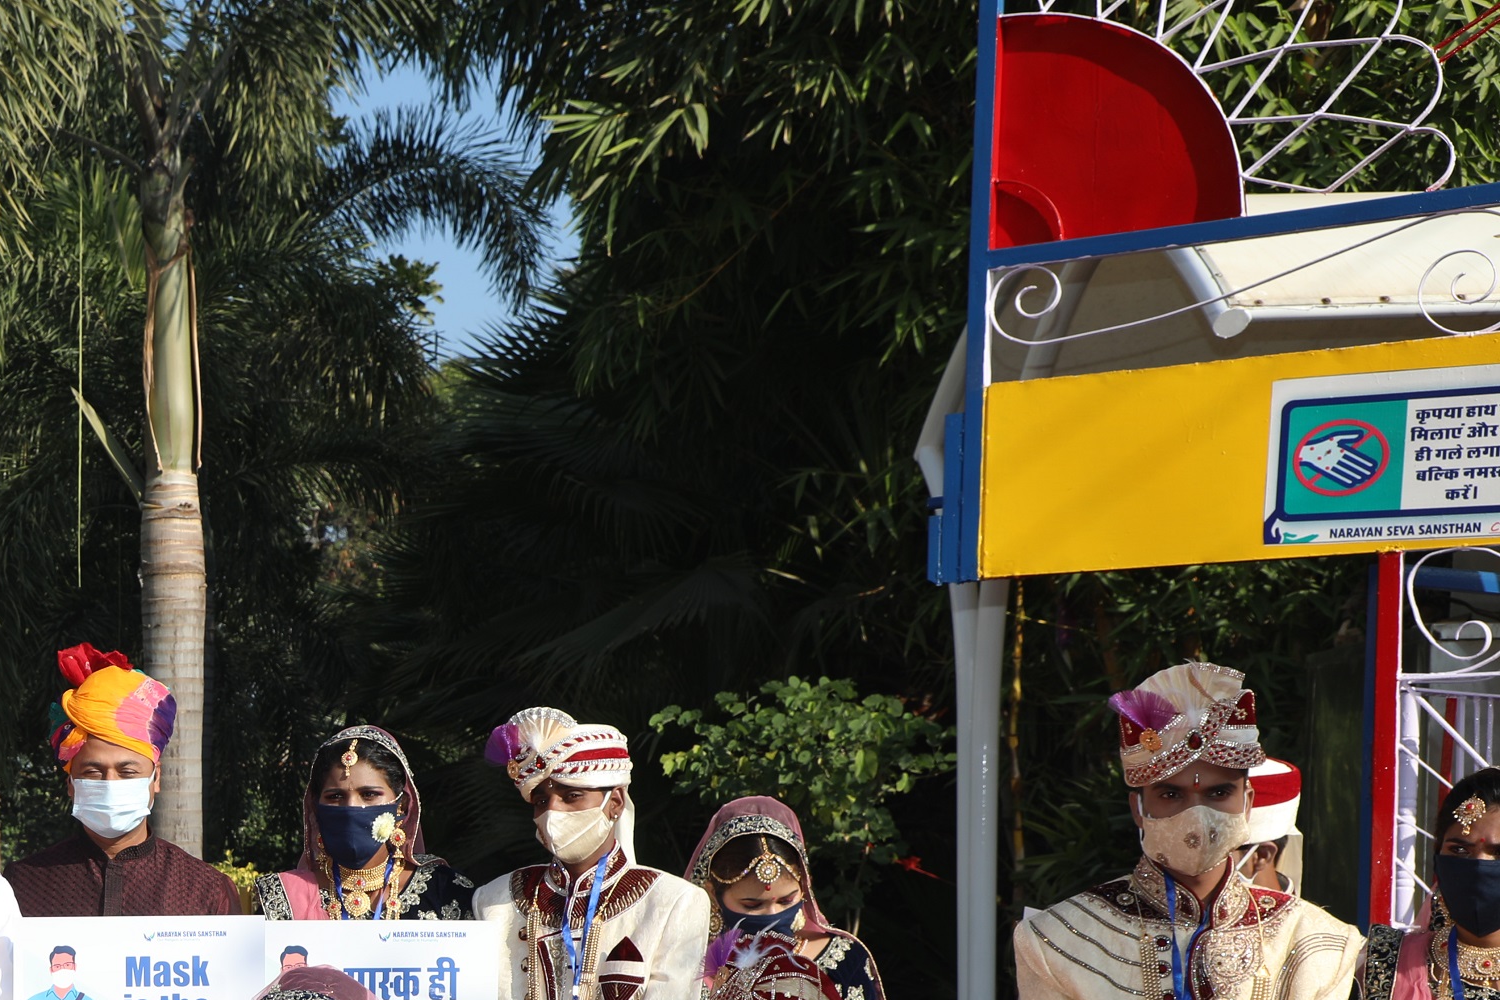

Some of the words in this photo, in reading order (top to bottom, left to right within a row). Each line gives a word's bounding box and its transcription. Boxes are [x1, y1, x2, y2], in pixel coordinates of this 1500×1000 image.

[1415, 406, 1464, 425] कृपया
[1465, 404, 1498, 418] हाथ
[1410, 422, 1466, 442] मिलाएं
[1466, 421, 1499, 438] और
[1414, 446, 1433, 462] ही
[1434, 443, 1464, 460] गले
[1466, 445, 1500, 459] लगा
[1415, 465, 1461, 482] बल्कि
[1329, 526, 1383, 539] NARAYAN
[1386, 524, 1415, 537] SEVA
[1418, 522, 1482, 535] SANSTHAN
[156, 930, 182, 938] NARAYAN
[182, 930, 197, 938] SEVA
[197, 930, 227, 938] SANSTHAN
[125, 955, 210, 988] Mask
[427, 956, 460, 1000] ही
